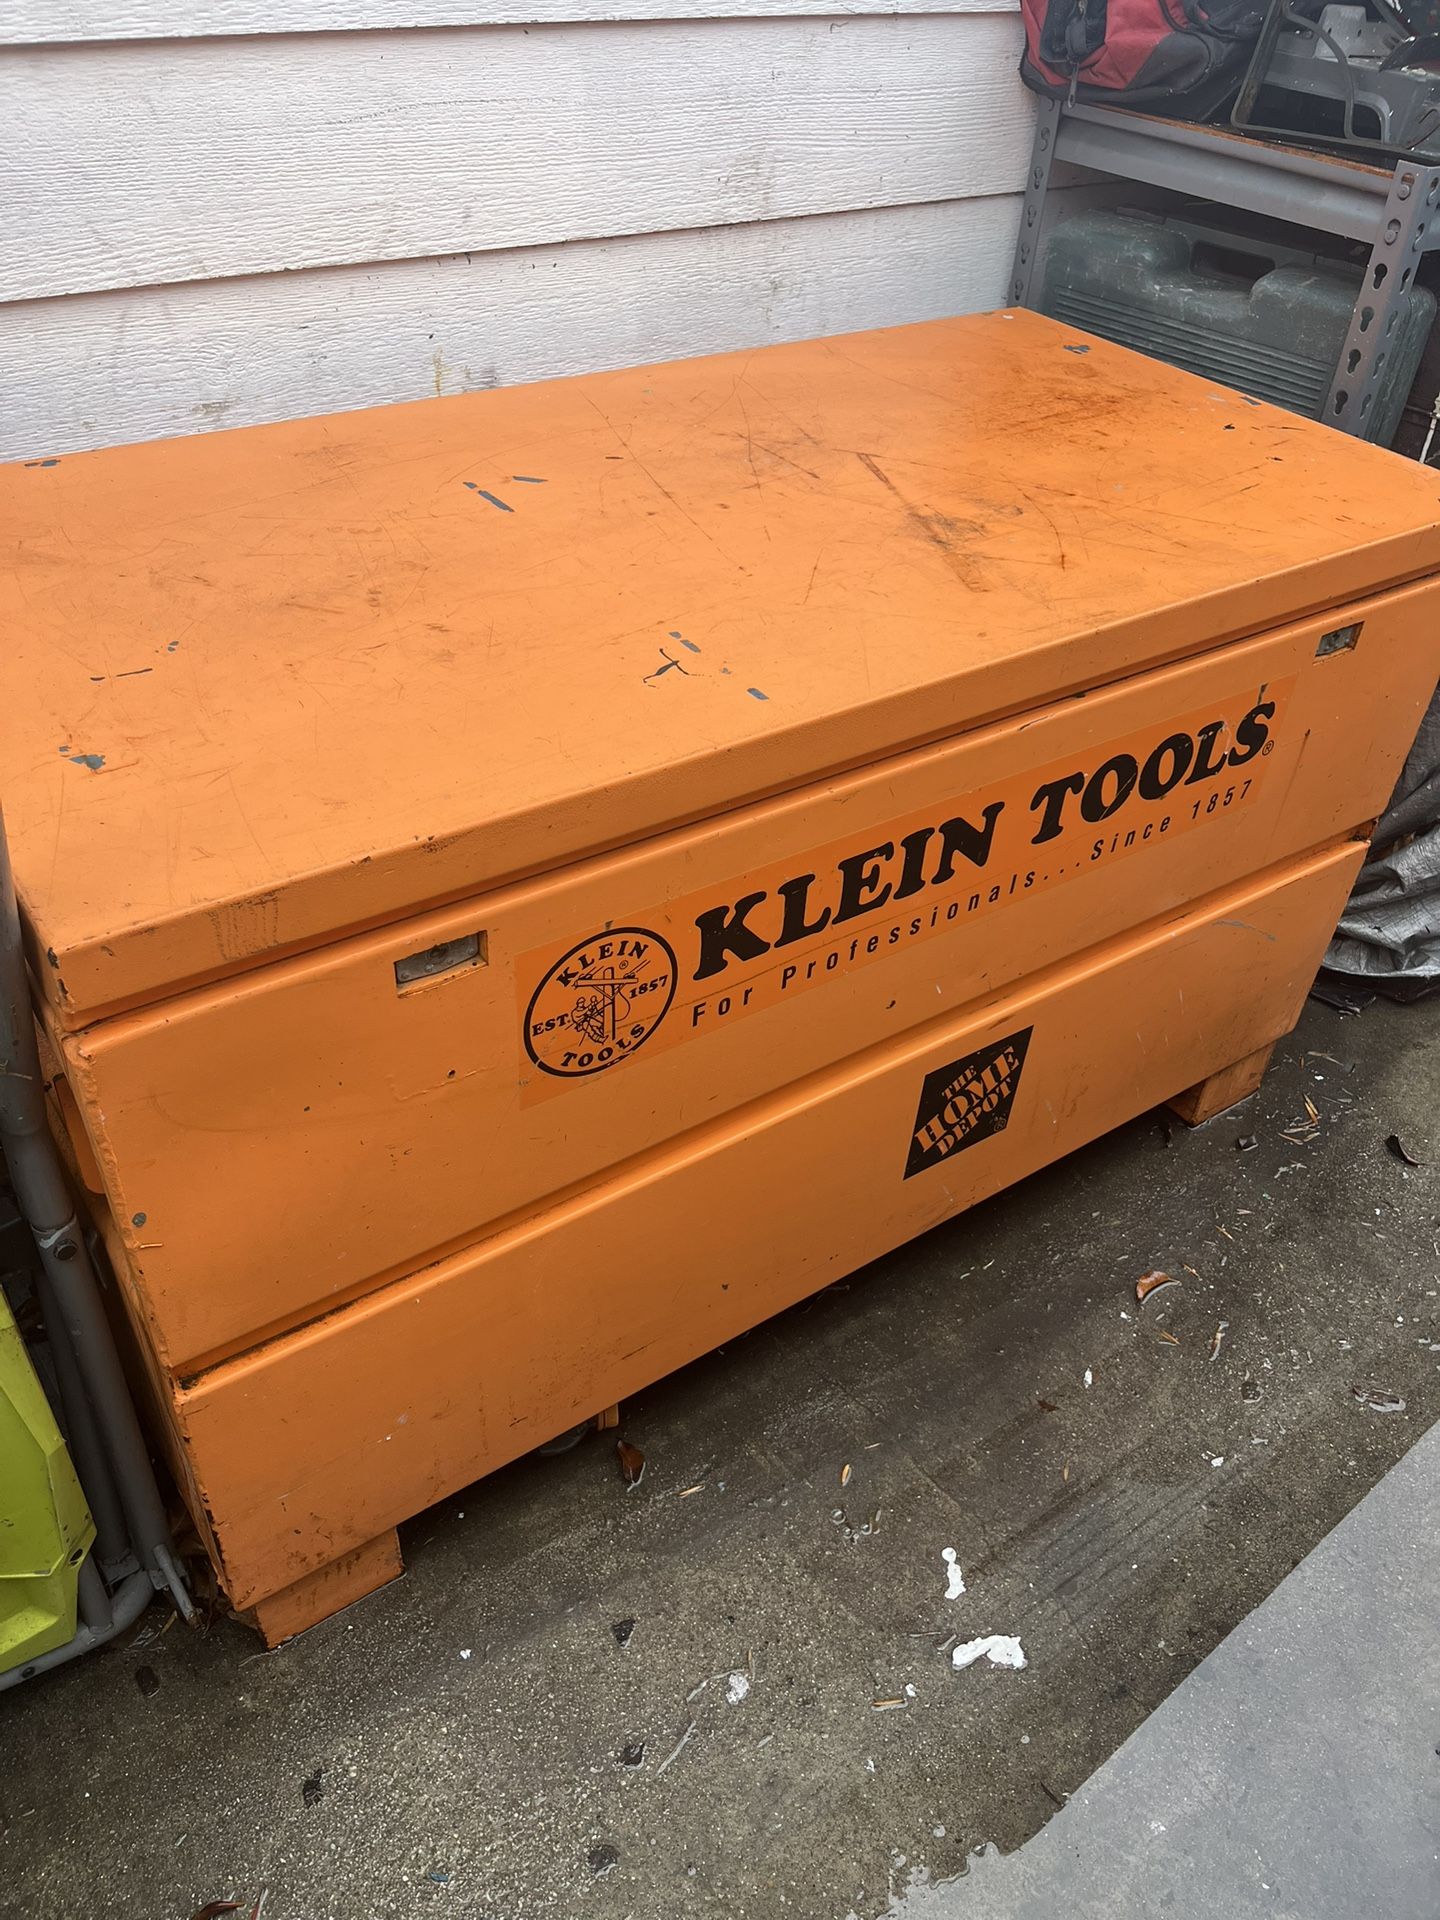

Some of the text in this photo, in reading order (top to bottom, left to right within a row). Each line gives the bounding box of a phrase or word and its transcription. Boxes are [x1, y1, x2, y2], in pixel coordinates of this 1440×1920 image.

[692, 986, 753, 1027] For
[1191, 779, 1253, 820] 1857
[693, 801, 1005, 981] KLEIN
[556, 940, 649, 988] KLEIN
[531, 974, 669, 1037] EST. 1857
[560, 1023, 645, 1068] TOOLS
[914, 1045, 1020, 1153] HOME
[935, 1077, 1011, 1157] DEPOT
[941, 1064, 977, 1100] THE
